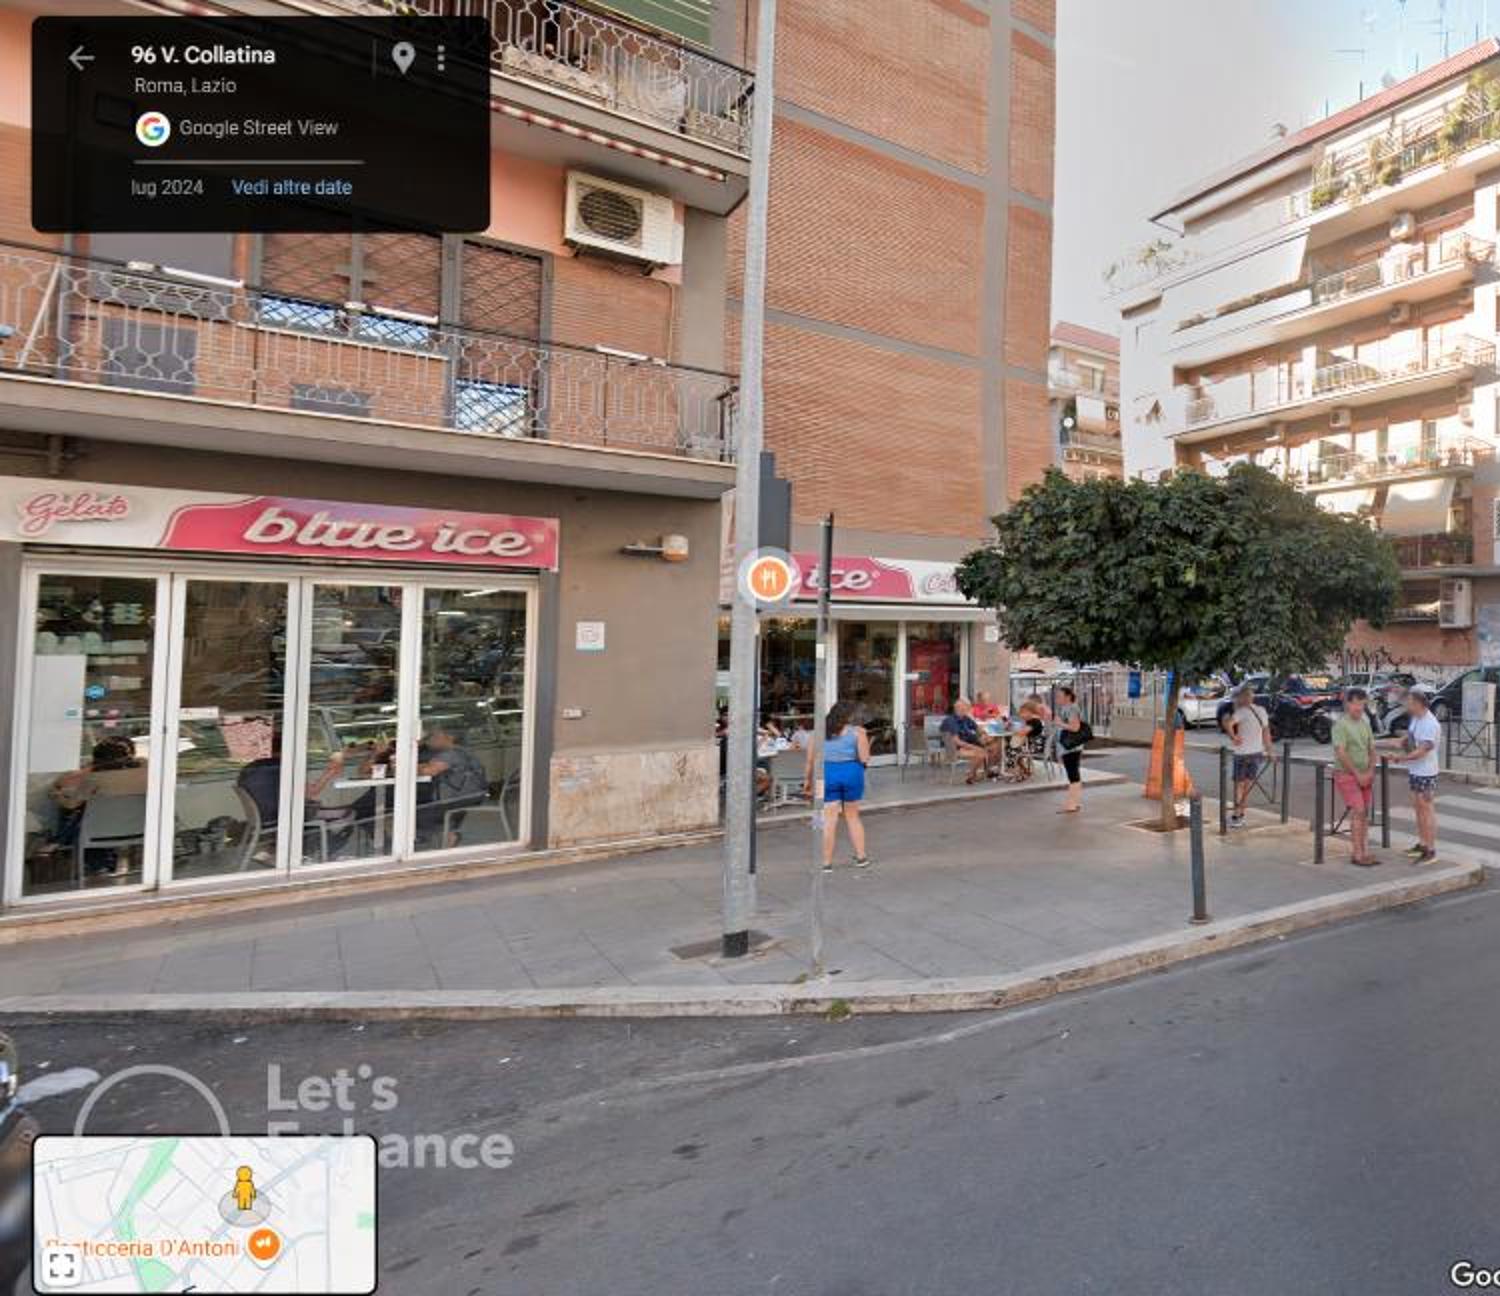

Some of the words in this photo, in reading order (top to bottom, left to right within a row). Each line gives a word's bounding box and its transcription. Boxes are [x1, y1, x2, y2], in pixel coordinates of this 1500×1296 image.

[19, 491, 129, 536] Gelato
[243, 507, 424, 550] blue
[431, 522, 533, 556] ice
